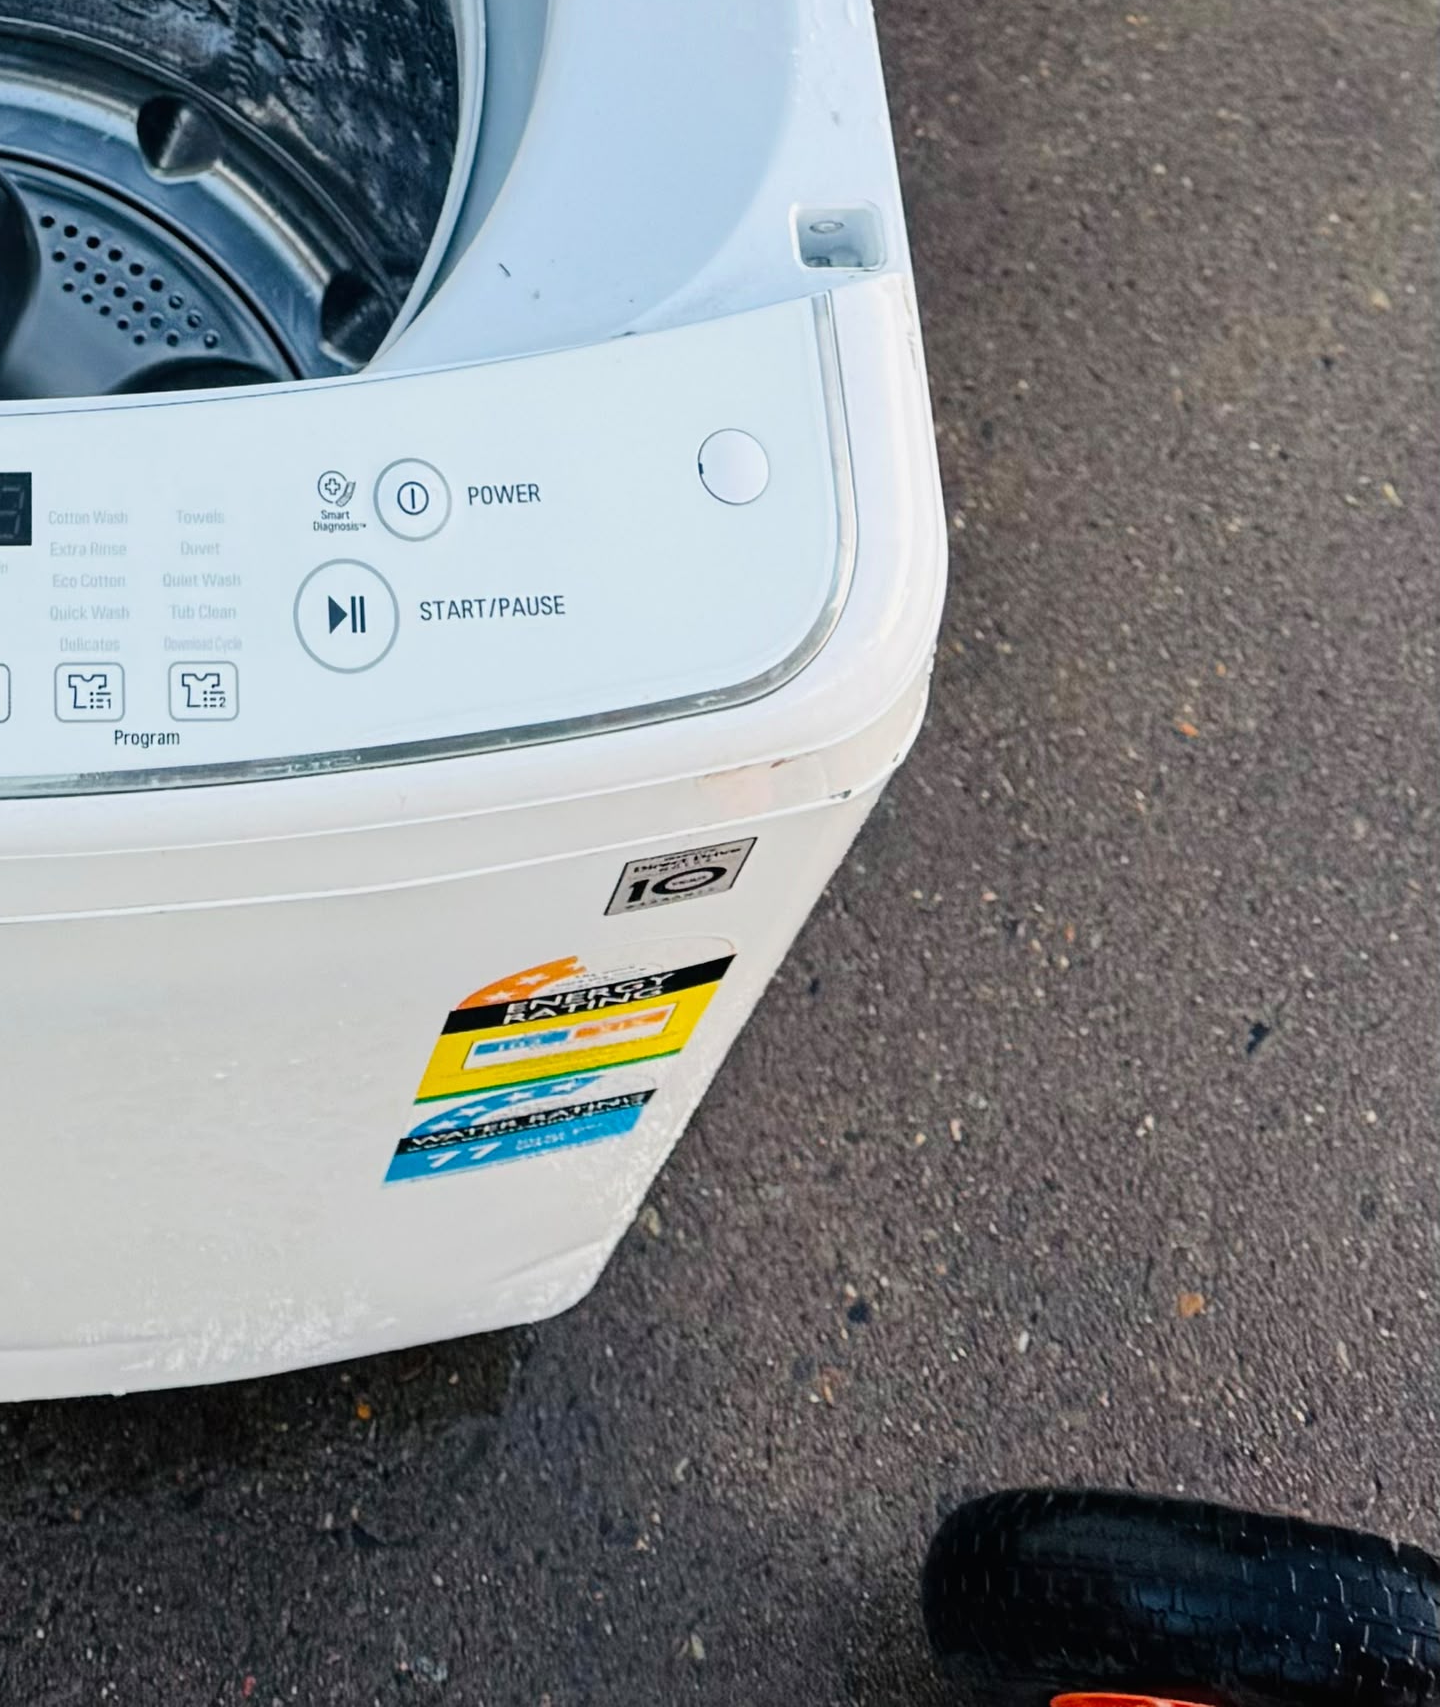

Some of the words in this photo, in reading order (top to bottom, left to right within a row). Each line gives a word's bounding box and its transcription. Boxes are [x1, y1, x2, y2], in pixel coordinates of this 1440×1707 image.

[467, 483, 541, 505] POWER
[48, 510, 90, 525] Cotton
[92, 510, 129, 525] Wash
[175, 509, 225, 524] Towels
[320, 510, 350, 520] Smart
[49, 542, 87, 556] Extra
[89, 541, 127, 556] Rinse
[179, 541, 220, 556] Duvet
[52, 574, 78, 588] Eco
[80, 573, 126, 588] Cotton
[162, 572, 200, 588] Quiet
[202, 572, 241, 587] Wash
[49, 605, 88, 621] Quick
[90, 605, 130, 620] Wash
[170, 605, 195, 619] Tub
[198, 604, 236, 619] Clean
[419, 595, 566, 621] START/PAUSE
[59, 636, 120, 652] Delicates
[163, 636, 214, 651] Download
[215, 637, 243, 653] Cycle
[114, 730, 180, 749] Program
[507, 973, 675, 1014] ENERGY
[502, 987, 664, 1025] RATING
